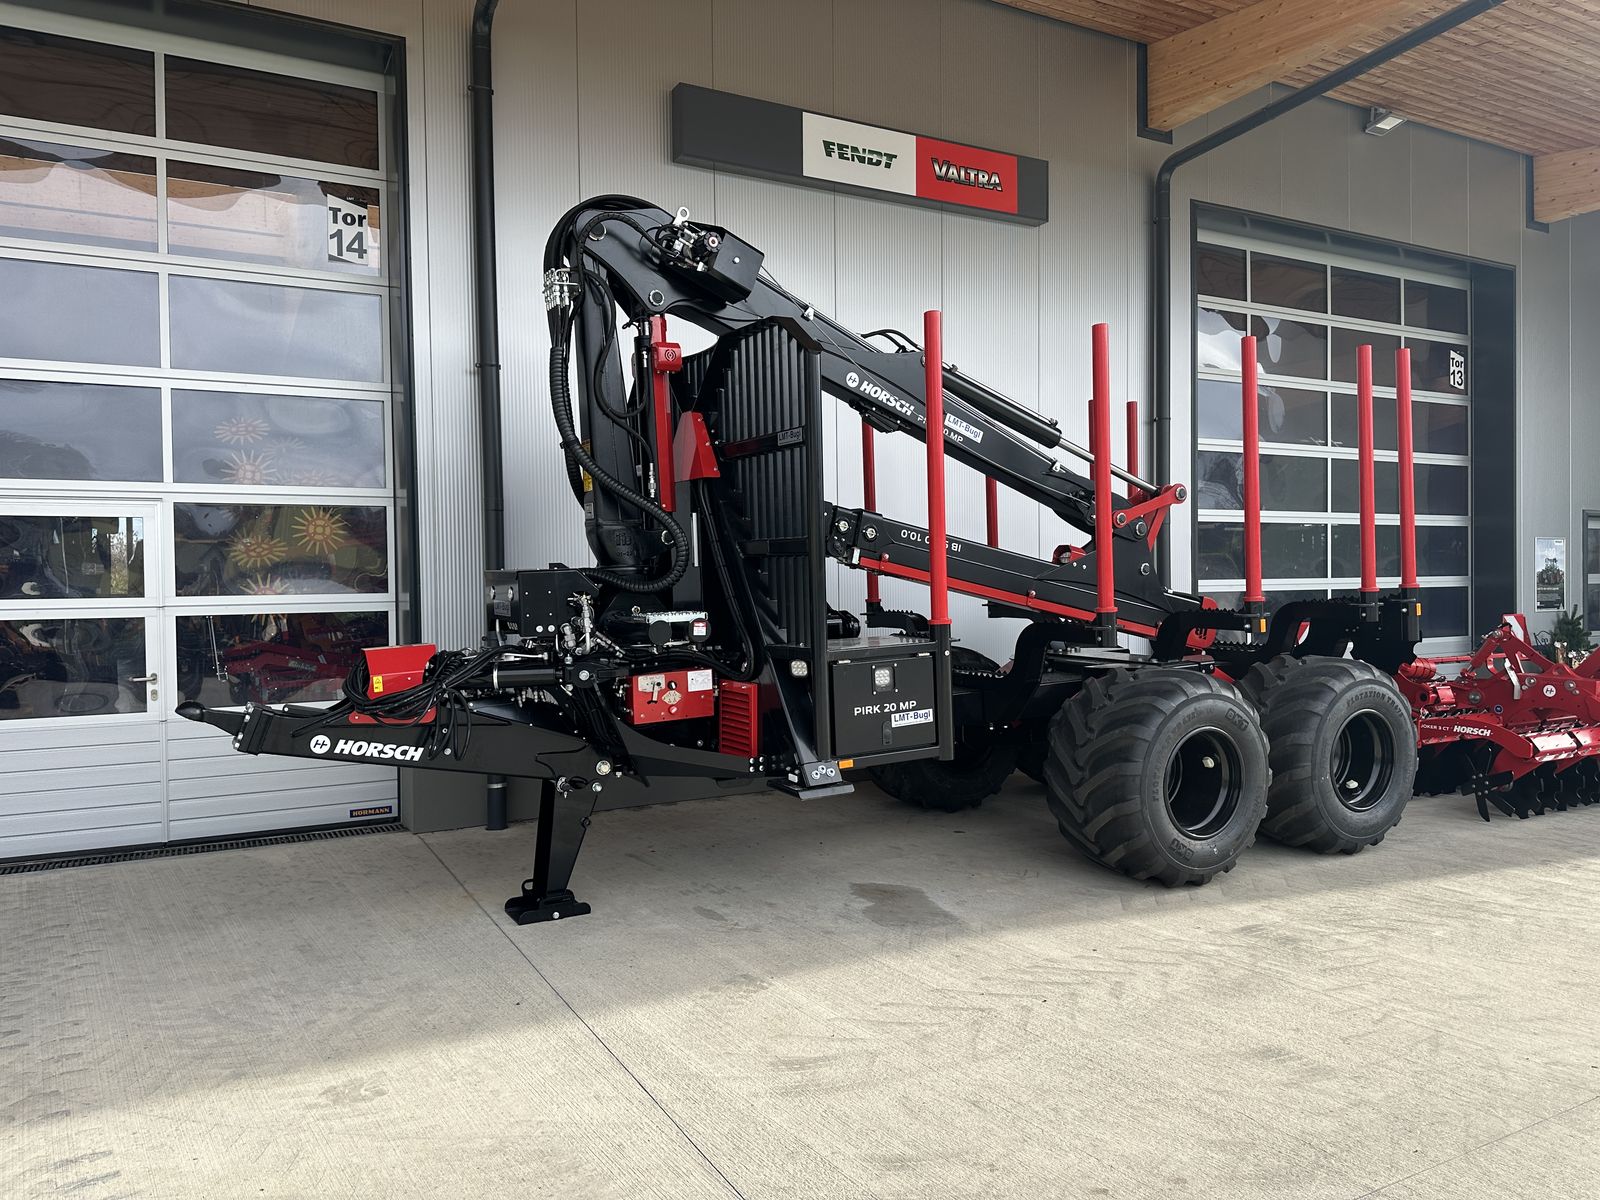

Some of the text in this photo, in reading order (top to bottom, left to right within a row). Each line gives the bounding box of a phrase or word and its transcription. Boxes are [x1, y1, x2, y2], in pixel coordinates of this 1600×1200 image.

[822, 139, 898, 169] FENDT
[931, 158, 1003, 192] VALTRA
[328, 206, 367, 228] Tor
[329, 228, 368, 260] 14
[1450, 357, 1464, 368] Tor
[1450, 369, 1464, 387] 13
[860, 380, 915, 417] HORSCH
[900, 529, 922, 542] 10.0
[854, 700, 917, 716] PIRK 20 MP
[893, 711, 931, 723] LMT-Bugl
[1225, 708, 1249, 731] BKT
[1453, 725, 1491, 737] HORSCH
[333, 739, 425, 761] HORSCH
